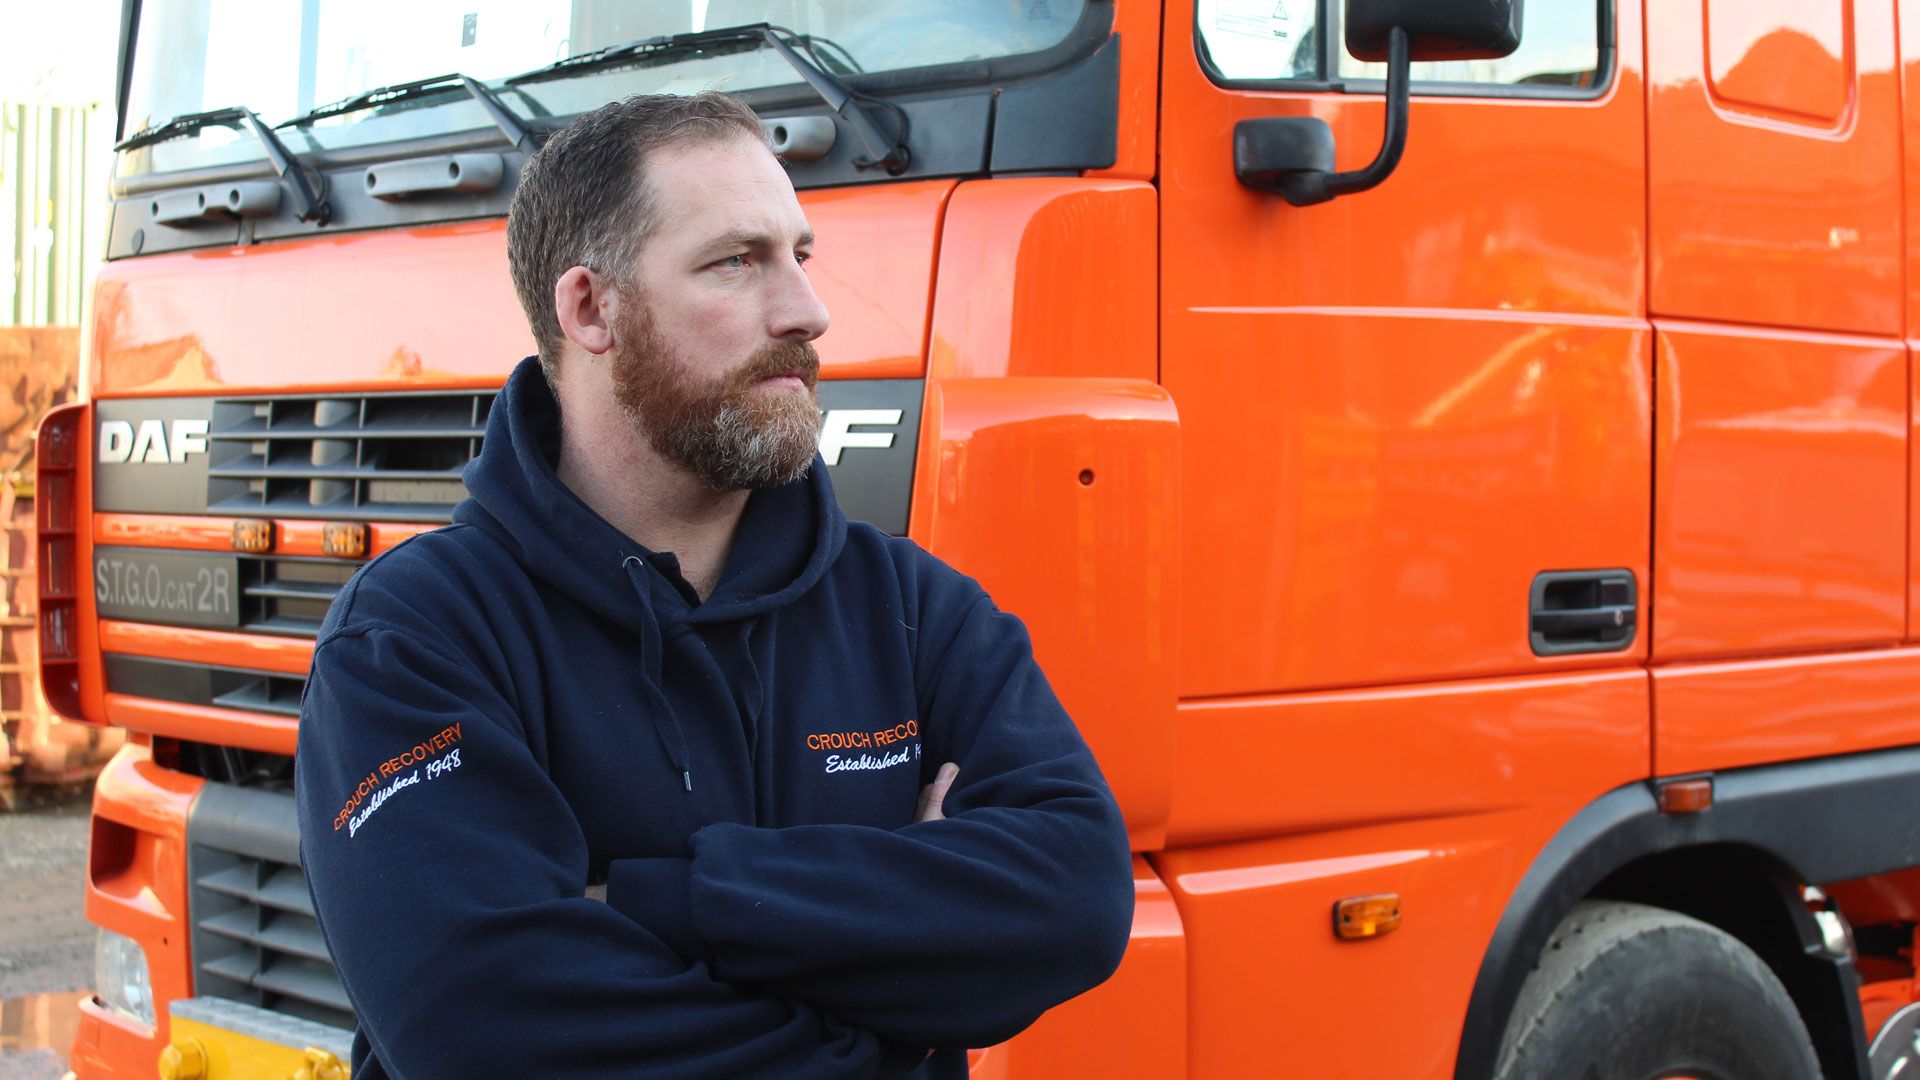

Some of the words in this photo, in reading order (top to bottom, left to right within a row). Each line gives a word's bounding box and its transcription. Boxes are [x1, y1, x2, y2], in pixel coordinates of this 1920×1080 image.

[99, 419, 210, 463] DAF
[818, 409, 904, 466] F
[806, 732, 872, 750] CROUCH
[873, 719, 919, 747] RECO
[825, 746, 910, 773] Established
[333, 772, 379, 831] CROUCH
[379, 722, 463, 778] RECOVERY
[349, 770, 420, 838] Established
[425, 748, 461, 780] 1948
